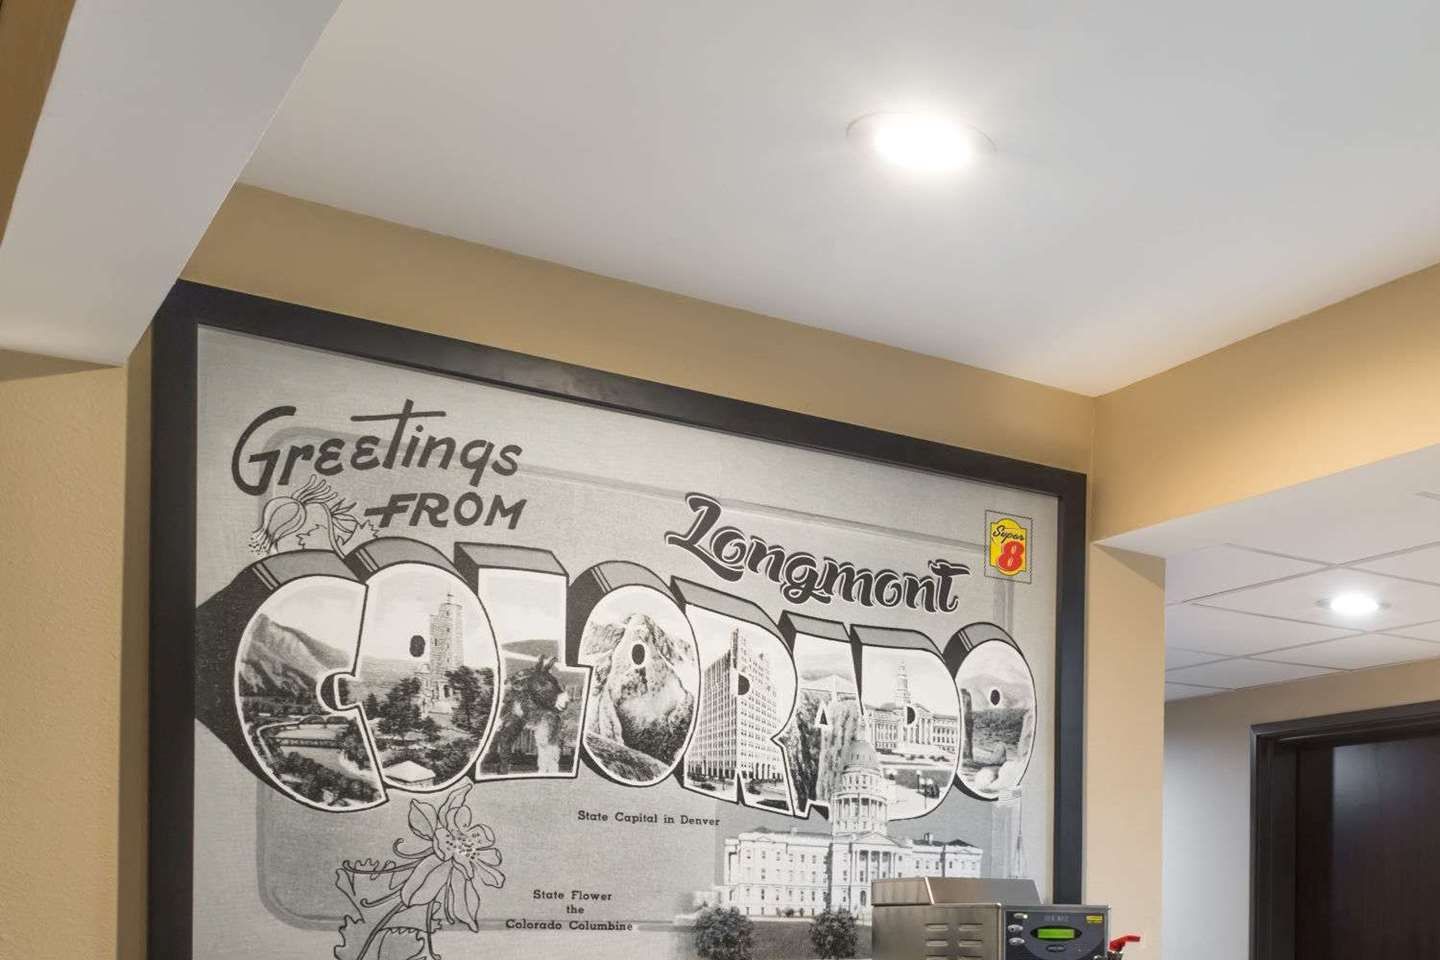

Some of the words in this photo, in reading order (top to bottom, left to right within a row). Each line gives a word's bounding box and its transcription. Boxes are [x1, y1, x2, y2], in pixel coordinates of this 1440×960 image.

[231, 398, 523, 496] Greetings
[363, 491, 528, 530] FROM
[992, 525, 1024, 543] Super
[664, 491, 970, 614] Longmont
[998, 541, 1025, 572] 8
[195, 537, 1038, 823] COLORADO
[578, 810, 608, 822] State
[614, 811, 658, 825] Capital
[664, 814, 674, 824] in
[680, 815, 720, 826] Denver
[533, 889, 564, 900] State
[571, 890, 612, 900] Flower
[566, 904, 584, 914] the
[505, 918, 562, 930] Colorado
[568, 920, 634, 931] Columbine
